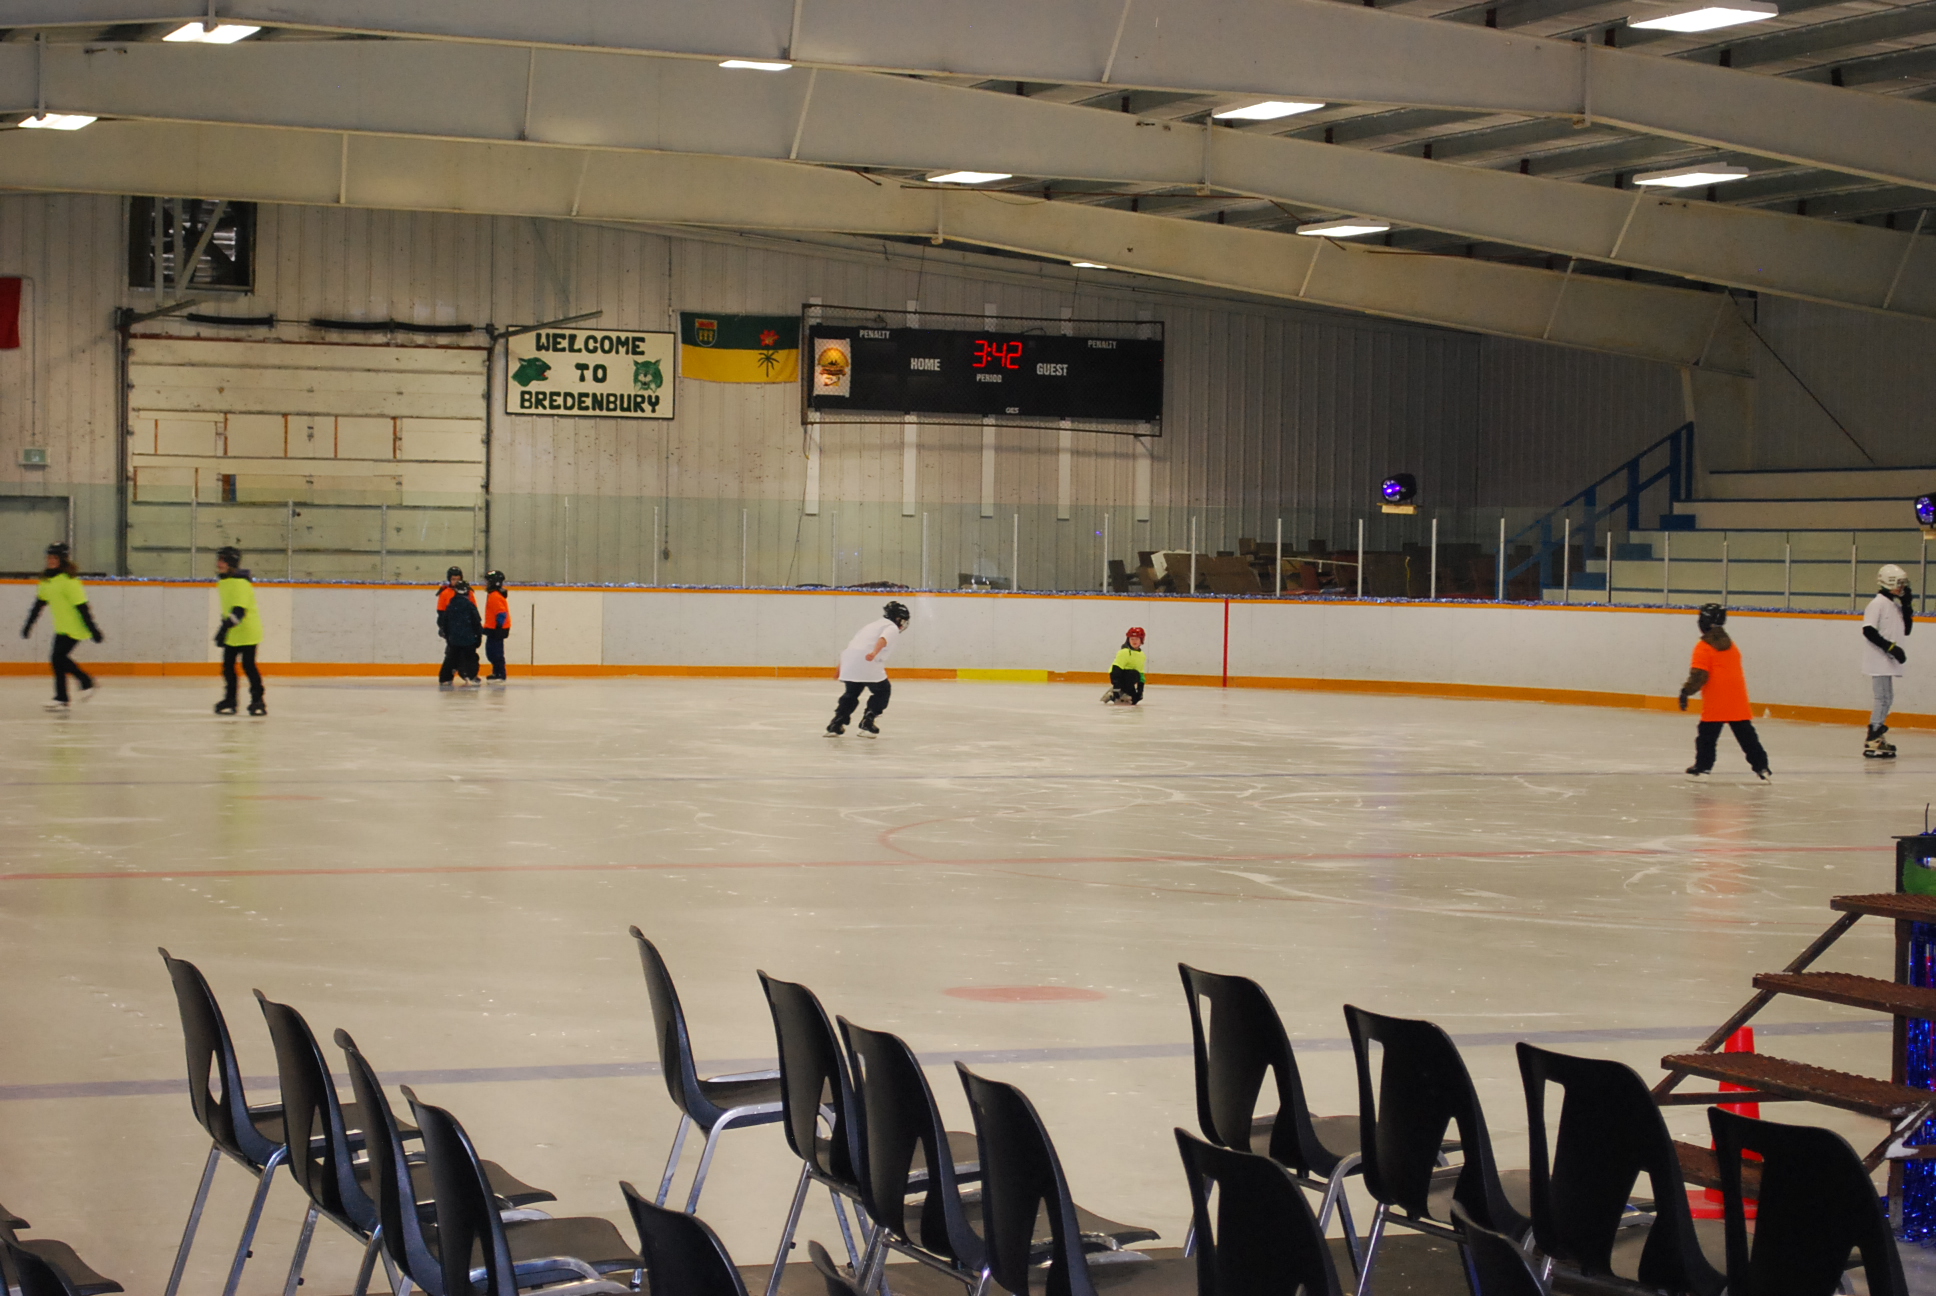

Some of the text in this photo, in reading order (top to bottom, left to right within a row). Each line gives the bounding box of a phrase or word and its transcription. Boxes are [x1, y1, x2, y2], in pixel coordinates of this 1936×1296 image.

[859, 329, 891, 339] PENALTY
[535, 332, 646, 356] WELCOME
[1087, 339, 1118, 349] PENALTY
[972, 340, 1023, 369] 3:42
[910, 357, 941, 371] HOME
[1036, 362, 1069, 376] GUEST
[574, 362, 608, 384] TO
[976, 373, 1003, 383] PERIOD
[519, 390, 661, 413] BREDENBURY
